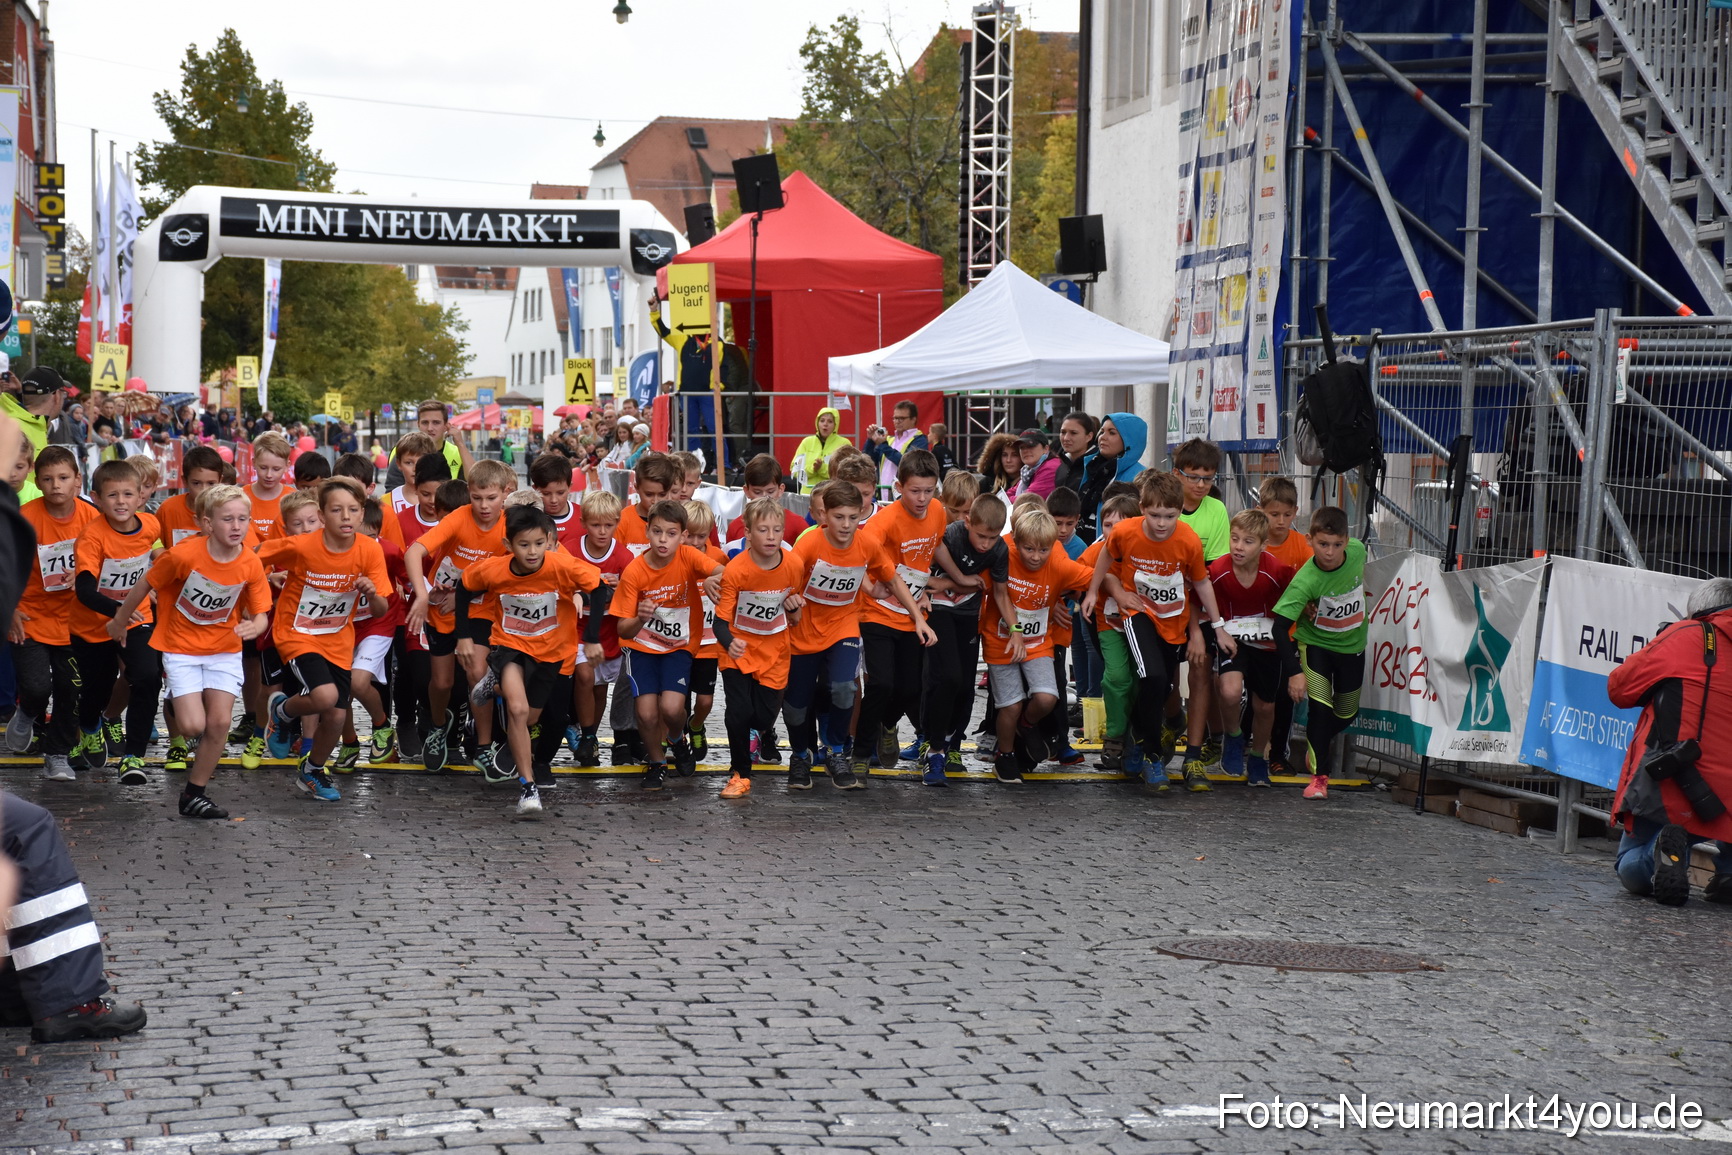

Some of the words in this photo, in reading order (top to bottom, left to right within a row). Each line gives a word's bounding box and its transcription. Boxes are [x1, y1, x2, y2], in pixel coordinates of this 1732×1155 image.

[256, 203, 349, 237] MINI
[359, 208, 584, 243] NEUMARKT.
[670, 283, 709, 296] Jugend
[683, 296, 703, 307] lauf
[98, 345, 124, 356] Block
[100, 358, 118, 381] A
[242, 366, 253, 380] B
[568, 361, 592, 369] Block
[572, 373, 588, 394] A
[329, 400, 337, 412] C
[343, 411, 350, 420] D
[818, 575, 855, 590] 7156
[190, 588, 231, 610] 7090
[1142, 584, 1178, 602] 7398
[308, 601, 347, 618] 7124
[510, 604, 548, 620] 7241
[1326, 600, 1360, 619] 7200
[1551, 706, 1595, 742] JEDER
